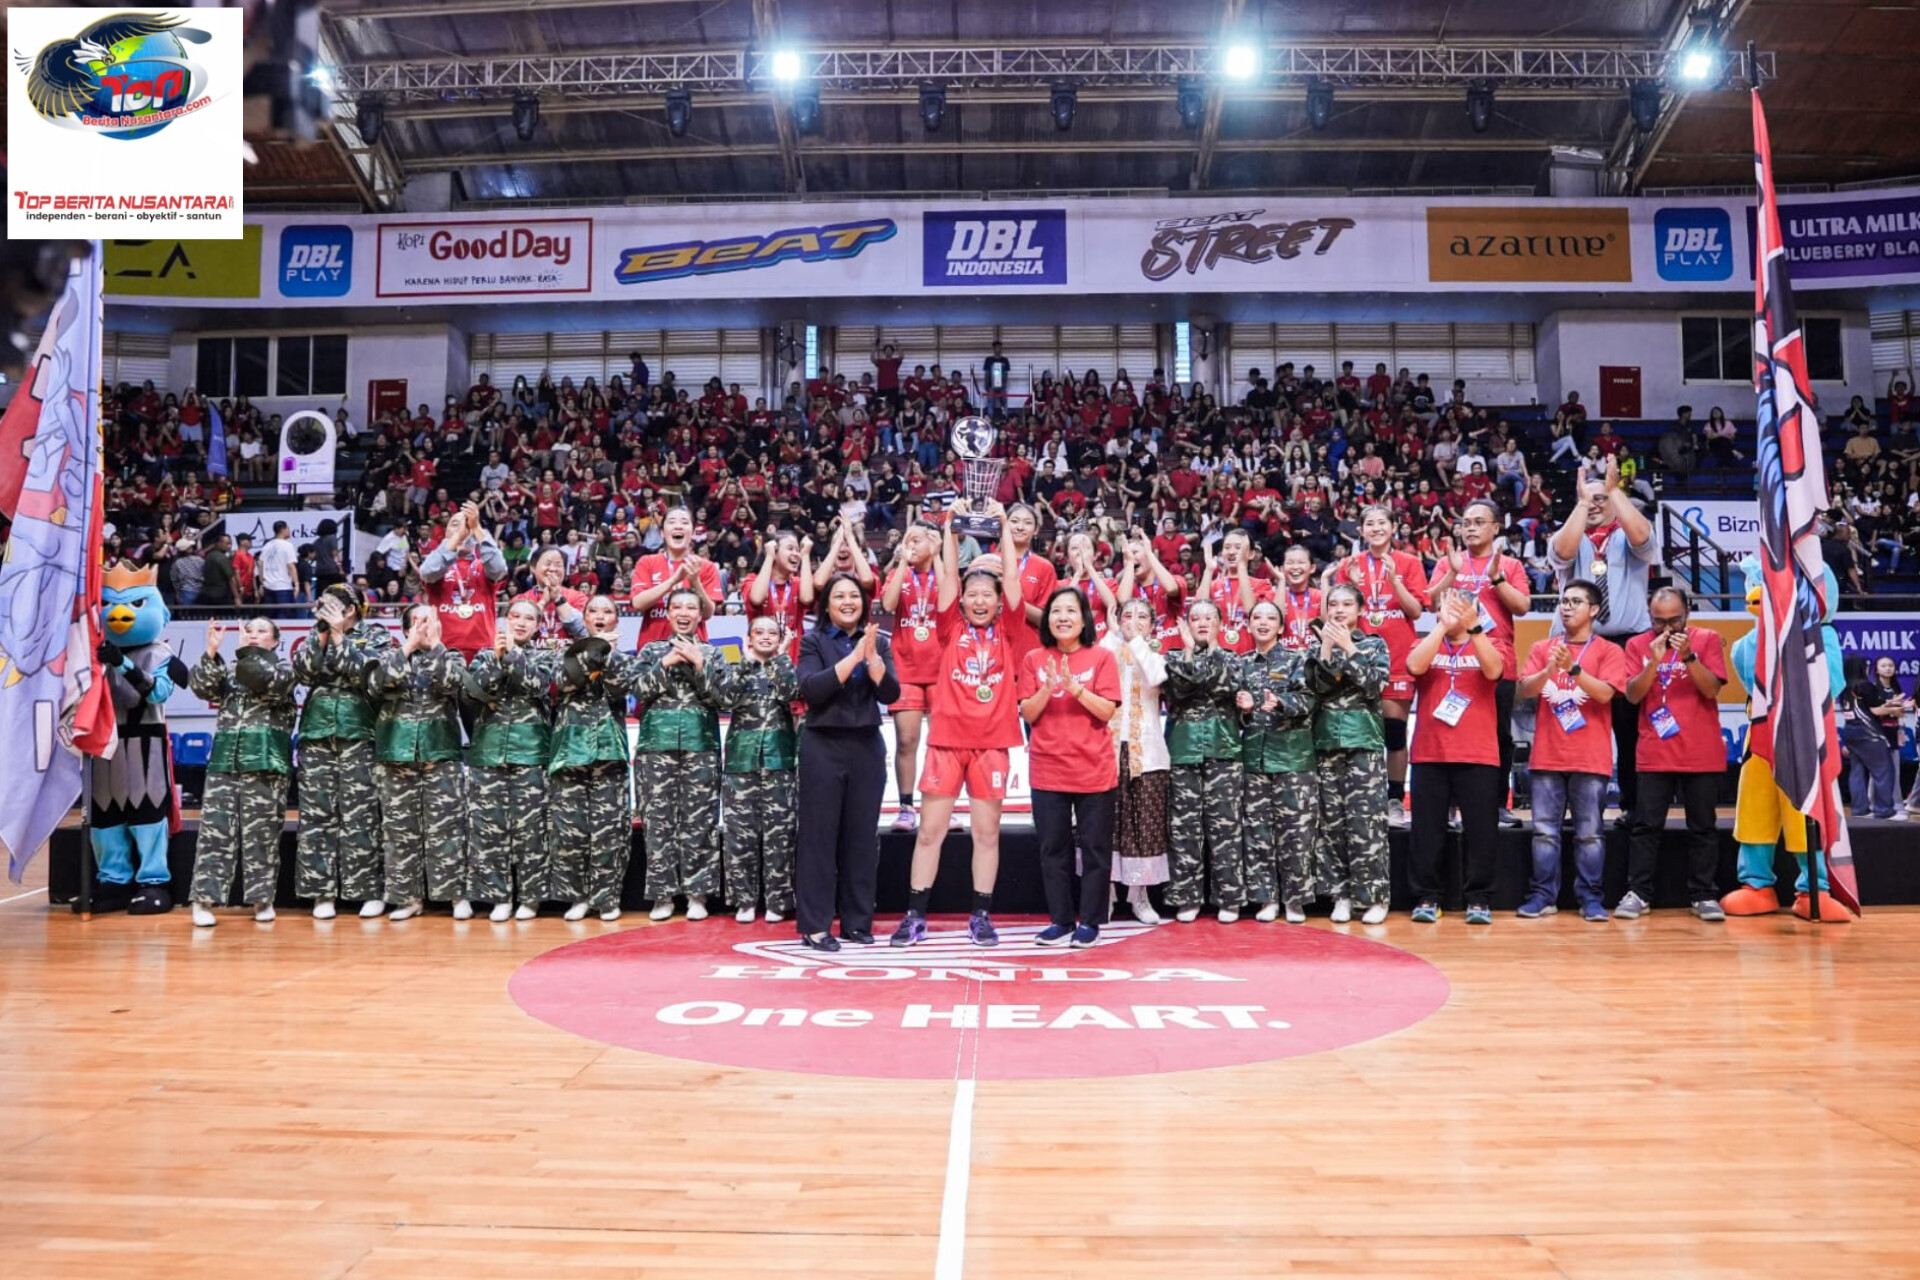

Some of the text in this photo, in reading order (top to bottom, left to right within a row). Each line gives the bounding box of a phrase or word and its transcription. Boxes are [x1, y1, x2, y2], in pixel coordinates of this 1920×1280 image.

[1790, 216, 1862, 237] ULTRA
[429, 230, 508, 261] Good
[512, 229, 571, 265] Day
[947, 220, 1043, 259] DBL
[1141, 217, 1355, 281] STREET
[1665, 227, 1723, 251] DBL
[1884, 241, 1920, 256] BLA
[287, 245, 344, 269] DBL
[1665, 252, 1720, 265] PLAY
[286, 269, 339, 281] PLAY
[946, 261, 1043, 276] INDONESIA
[1718, 516, 1760, 532] Bizn
[1862, 631, 1916, 650] MILK
[700, 965, 1249, 981] HONDA
[656, 1001, 1292, 1028] One HEART.
